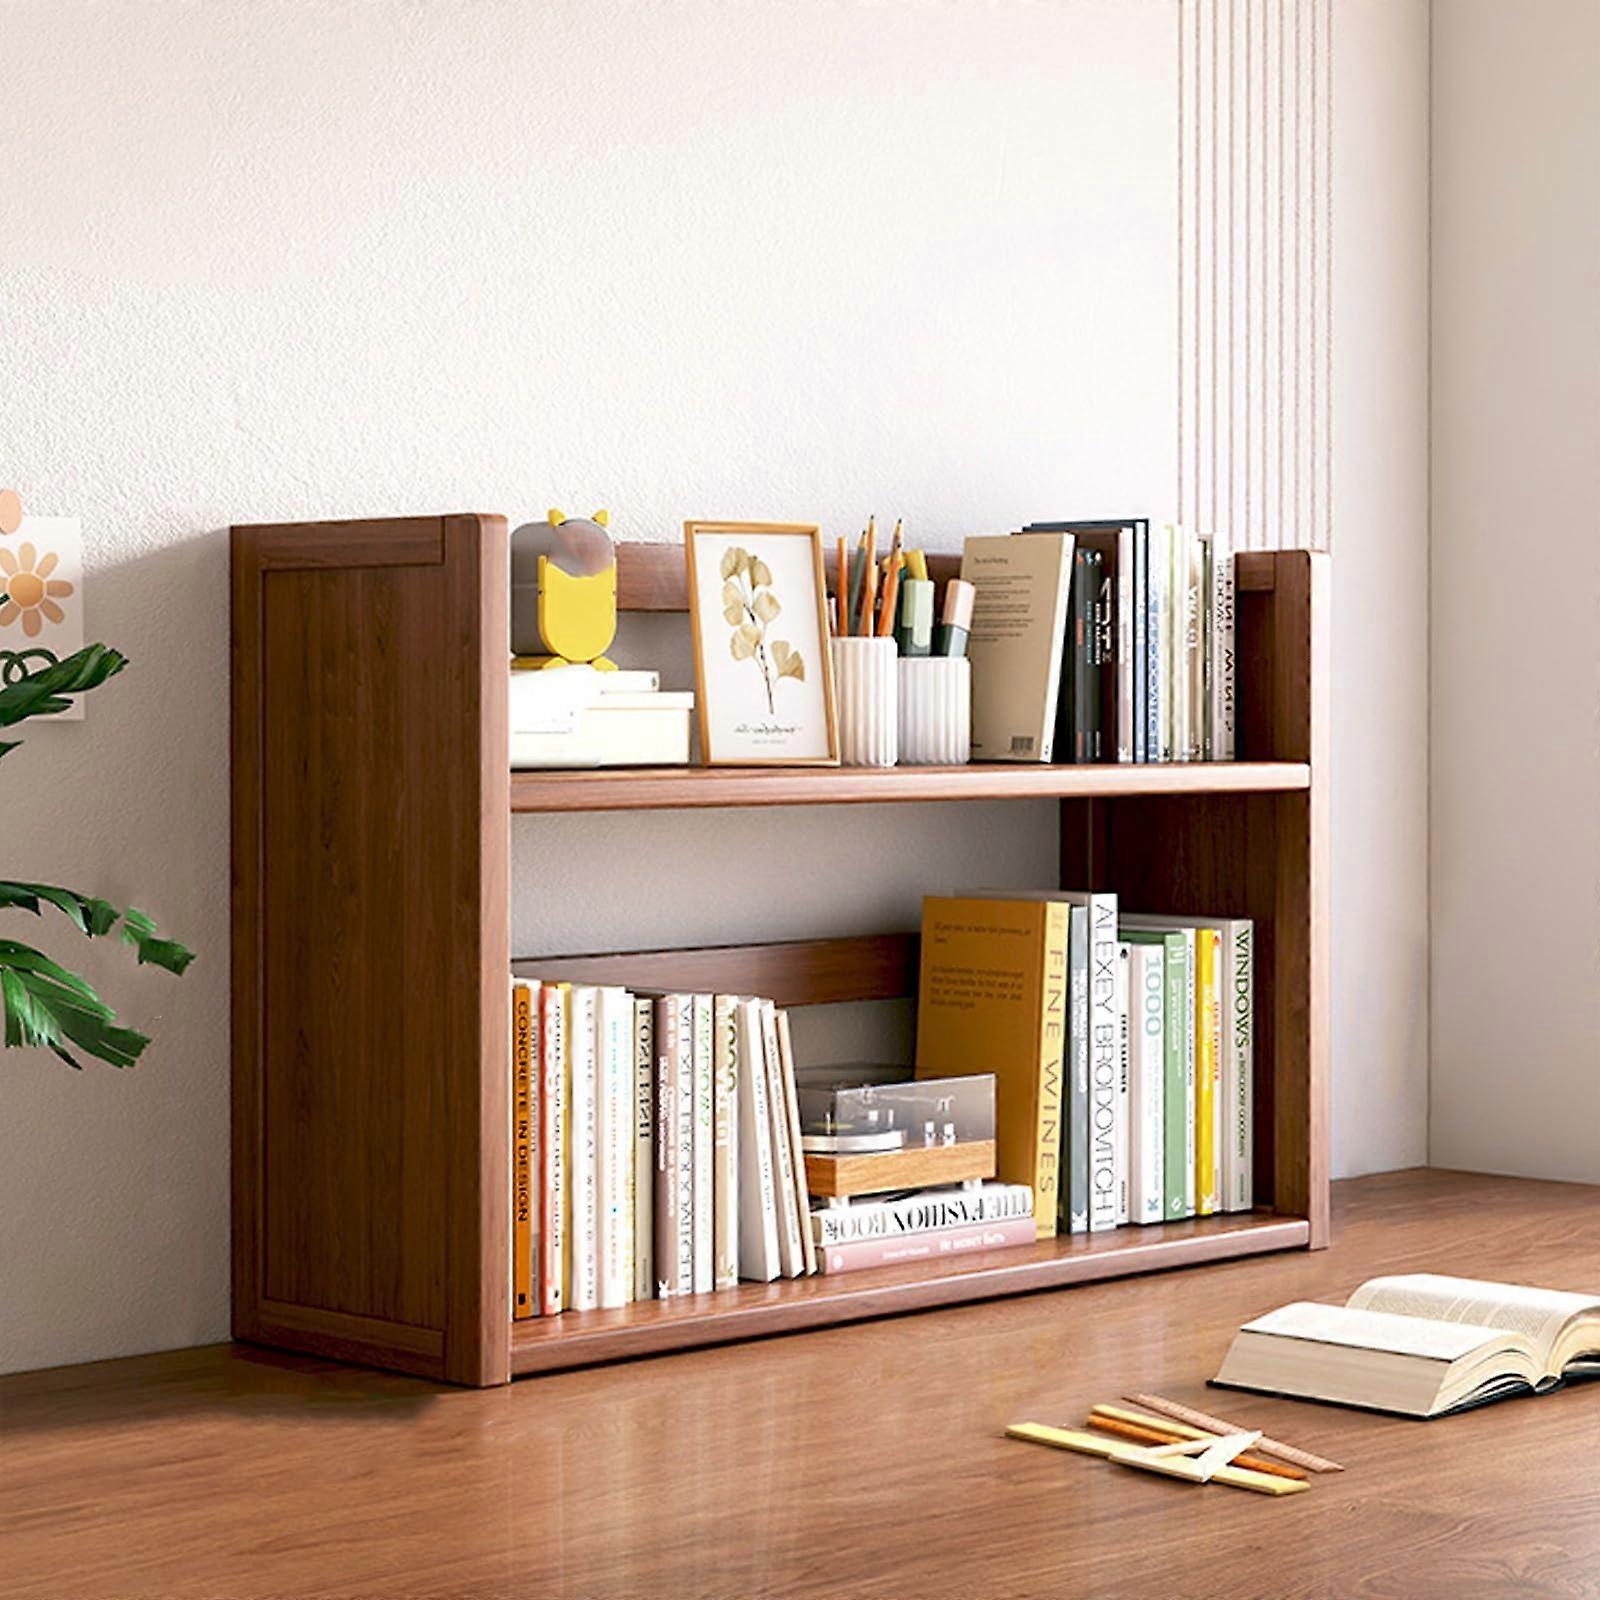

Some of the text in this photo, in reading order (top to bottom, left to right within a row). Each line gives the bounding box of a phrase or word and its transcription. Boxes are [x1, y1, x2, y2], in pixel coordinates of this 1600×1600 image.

[1045, 949, 1063, 1038] FINE
[1145, 957, 1162, 1036] 1000
[1235, 929, 1250, 1049] WINDOWS
[518, 1001, 528, 1221] CONCRETE IN DESIGN
[1095, 903, 1114, 1212] ALEXEY BRODOVITCH
[585, 998, 593, 1300] LET THE GREAT WORLD SPIN
[1039, 1059, 1061, 1193] WINES
[892, 1197, 985, 1232] FASHION
[989, 1191, 1032, 1220] THE
